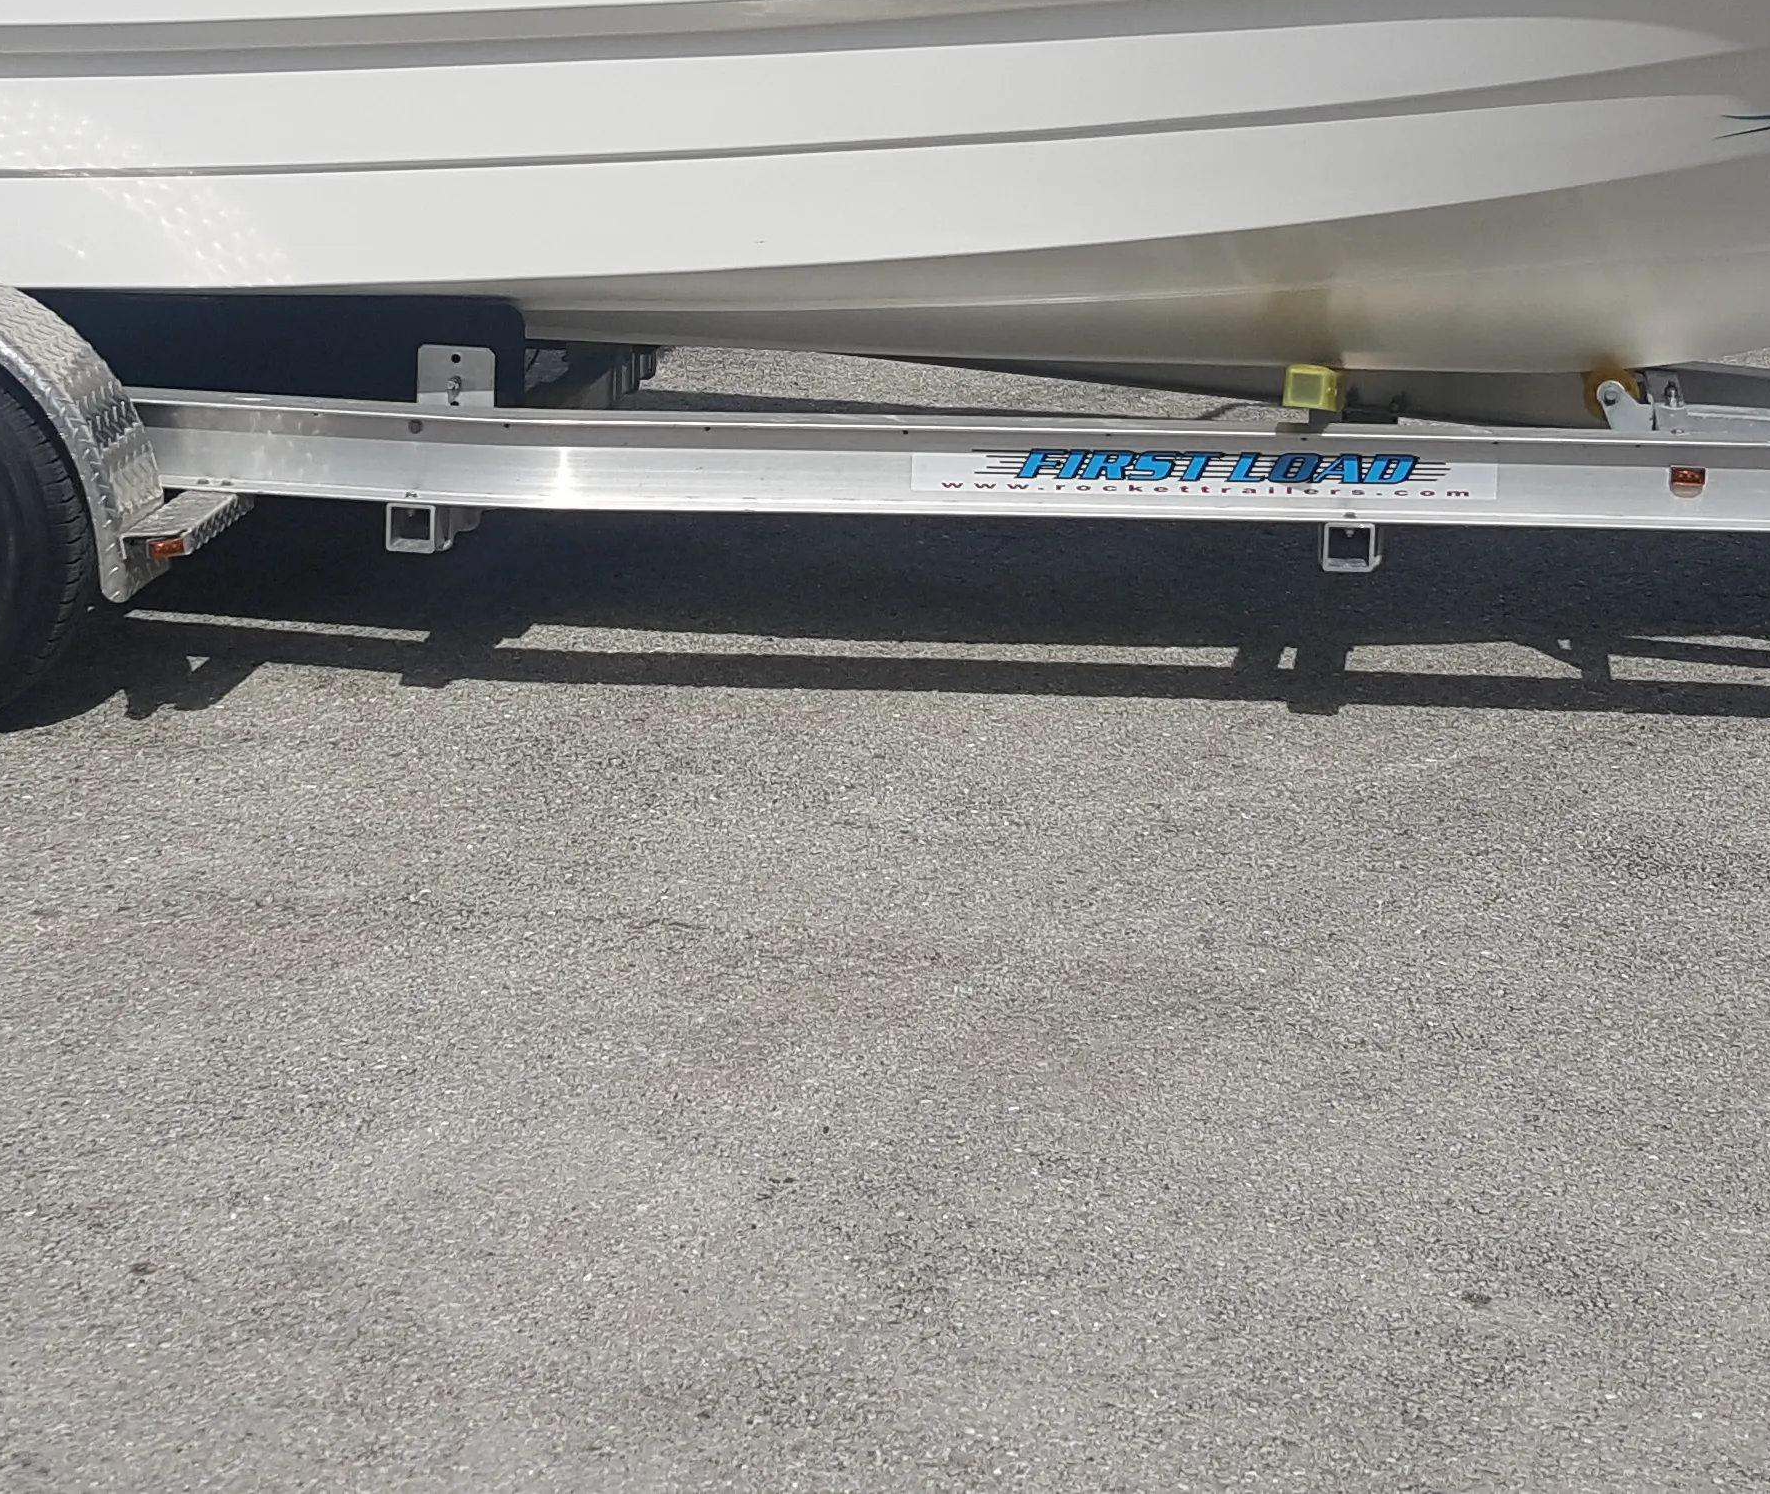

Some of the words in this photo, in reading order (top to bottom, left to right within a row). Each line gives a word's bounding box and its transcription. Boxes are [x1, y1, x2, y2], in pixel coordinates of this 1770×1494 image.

[1015, 449, 1225, 482] FIRST
[1226, 452, 1420, 485] LOAD
[942, 481, 1471, 498] www.rockettrailers.com
